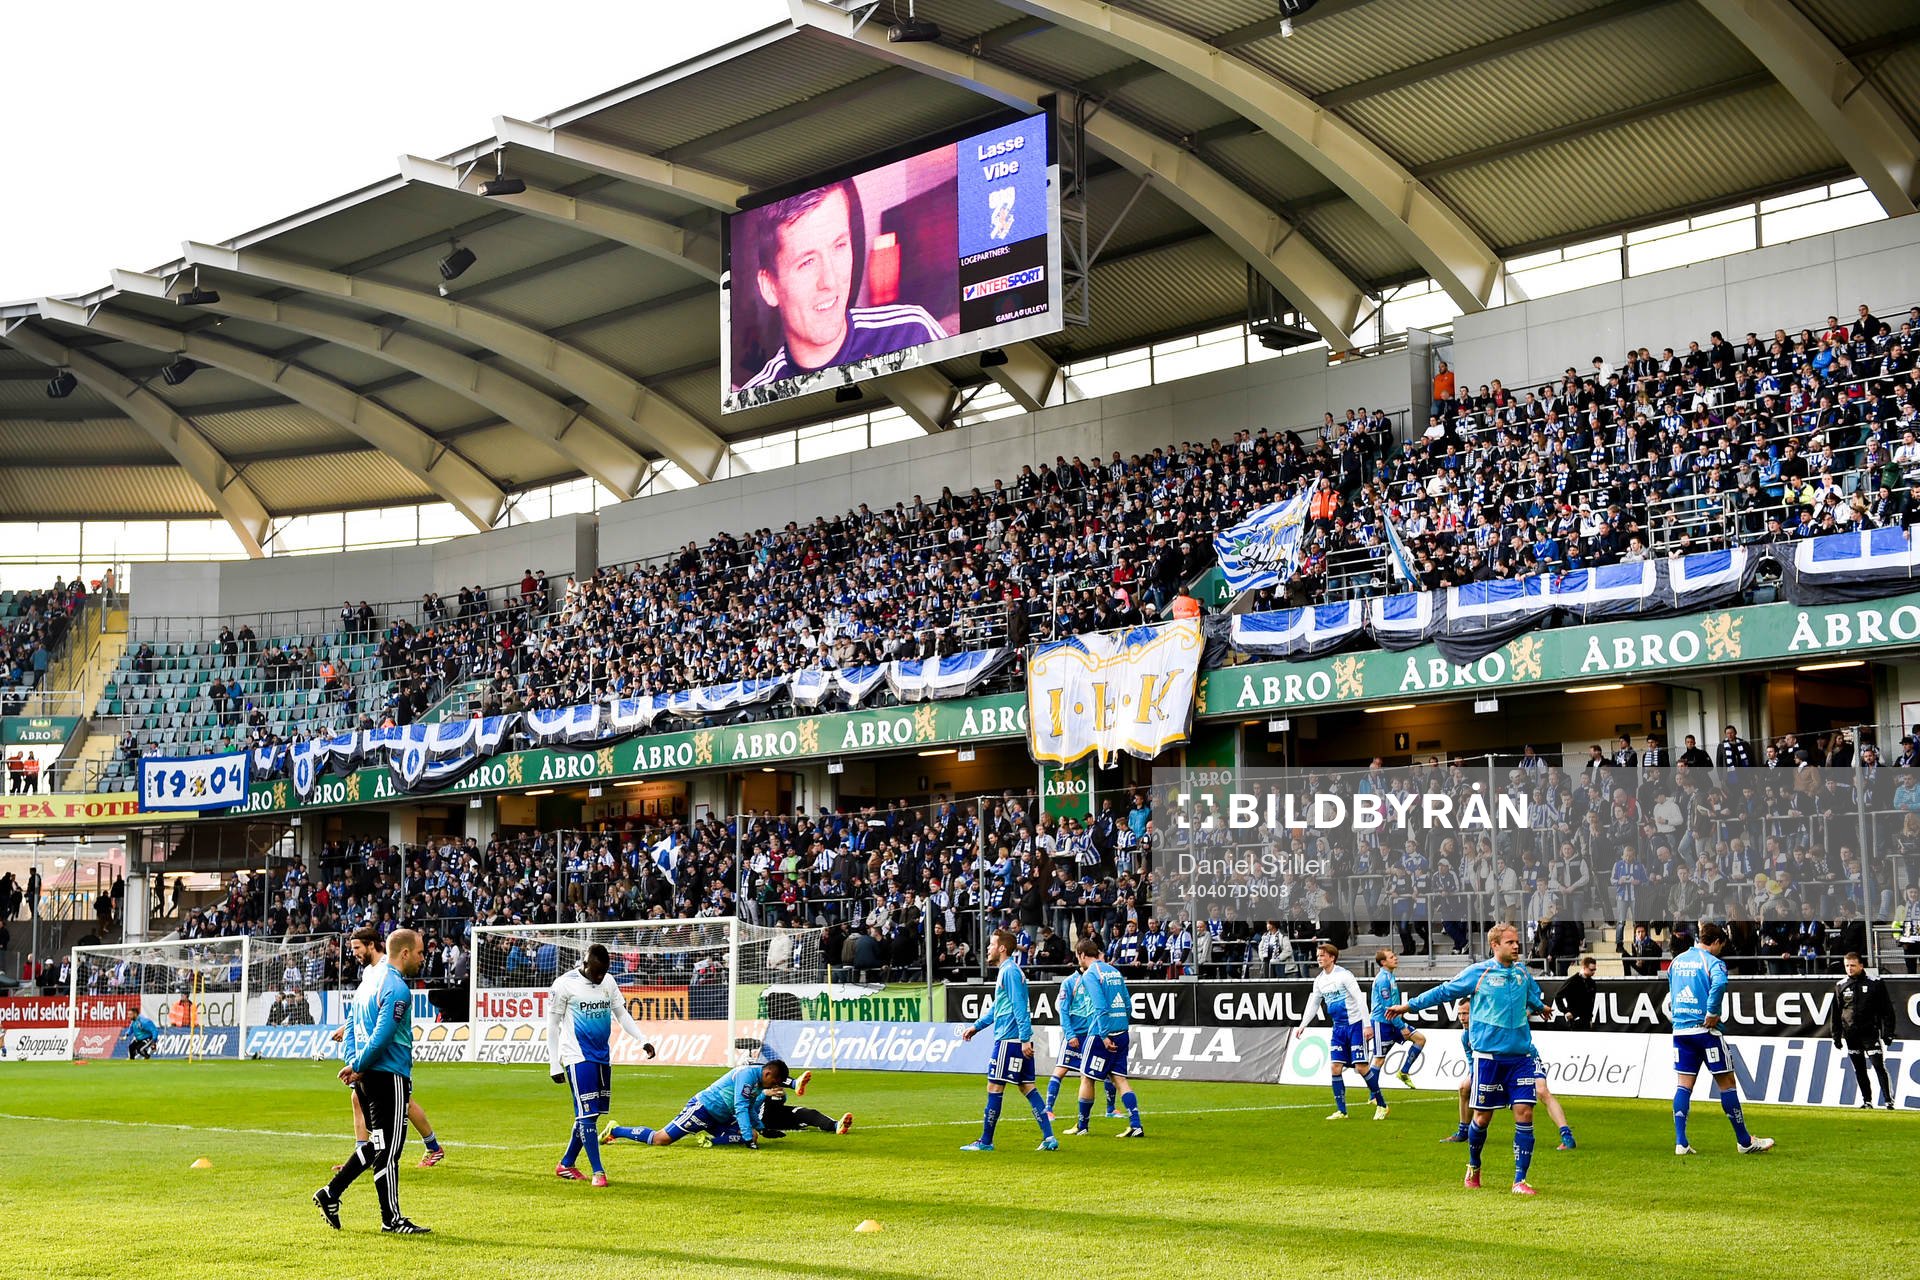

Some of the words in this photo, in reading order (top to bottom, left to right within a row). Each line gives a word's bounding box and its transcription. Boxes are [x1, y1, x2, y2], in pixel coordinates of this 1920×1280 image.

[978, 135, 1025, 161] Lasse
[983, 160, 1020, 182] Vibe
[976, 268, 1041, 297] INTERSPORT
[1788, 605, 1920, 652] ÅBRO
[1580, 630, 1700, 673] ÅBRO
[1399, 652, 1506, 692] ÅBRO
[1236, 672, 1332, 708] ÅBRO
[732, 731, 798, 760] ÅBRO
[841, 718, 913, 749] ÅBRO
[539, 754, 595, 781] ÅBRO
[633, 742, 693, 771] ÅBRO
[300, 782, 346, 805] BRO
[1045, 779, 1087, 796] ÅBRO
[19, 800, 57, 819] PÅ
[22, 1002, 38, 1021] vid
[82, 1002, 88, 1020] F
[90, 1001, 115, 1021] eller
[117, 1002, 126, 1020] N
[625, 997, 684, 1020] OTUN
[16, 1035, 68, 1055] Shopping
[412, 1043, 466, 1062] SJÖHUS
